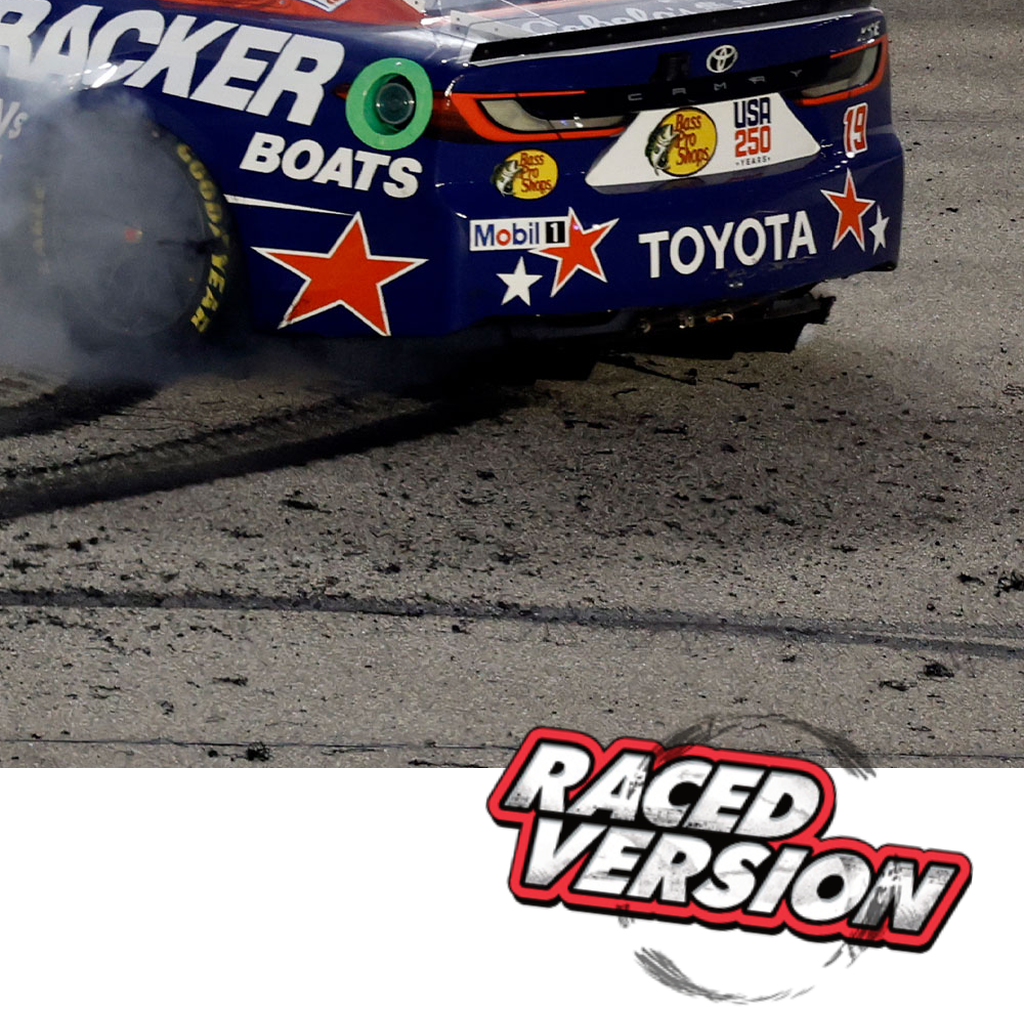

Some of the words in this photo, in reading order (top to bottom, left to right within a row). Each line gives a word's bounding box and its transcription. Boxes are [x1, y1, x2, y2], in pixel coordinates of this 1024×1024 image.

[627, 69, 803, 102] CAMRY
[674, 114, 702, 131] Bass
[733, 97, 771, 129] USA
[675, 130, 697, 149] Pro
[845, 104, 867, 152] 19
[734, 125, 771, 158] 250
[239, 131, 423, 199] BOATS
[519, 152, 545, 167] Bass
[676, 146, 709, 167] Shops
[740, 155, 767, 167] YEARS
[518, 165, 539, 181] Pro
[521, 178, 553, 195] Shops
[474, 221, 539, 247] Mobil
[638, 211, 818, 278] TOYOTA
